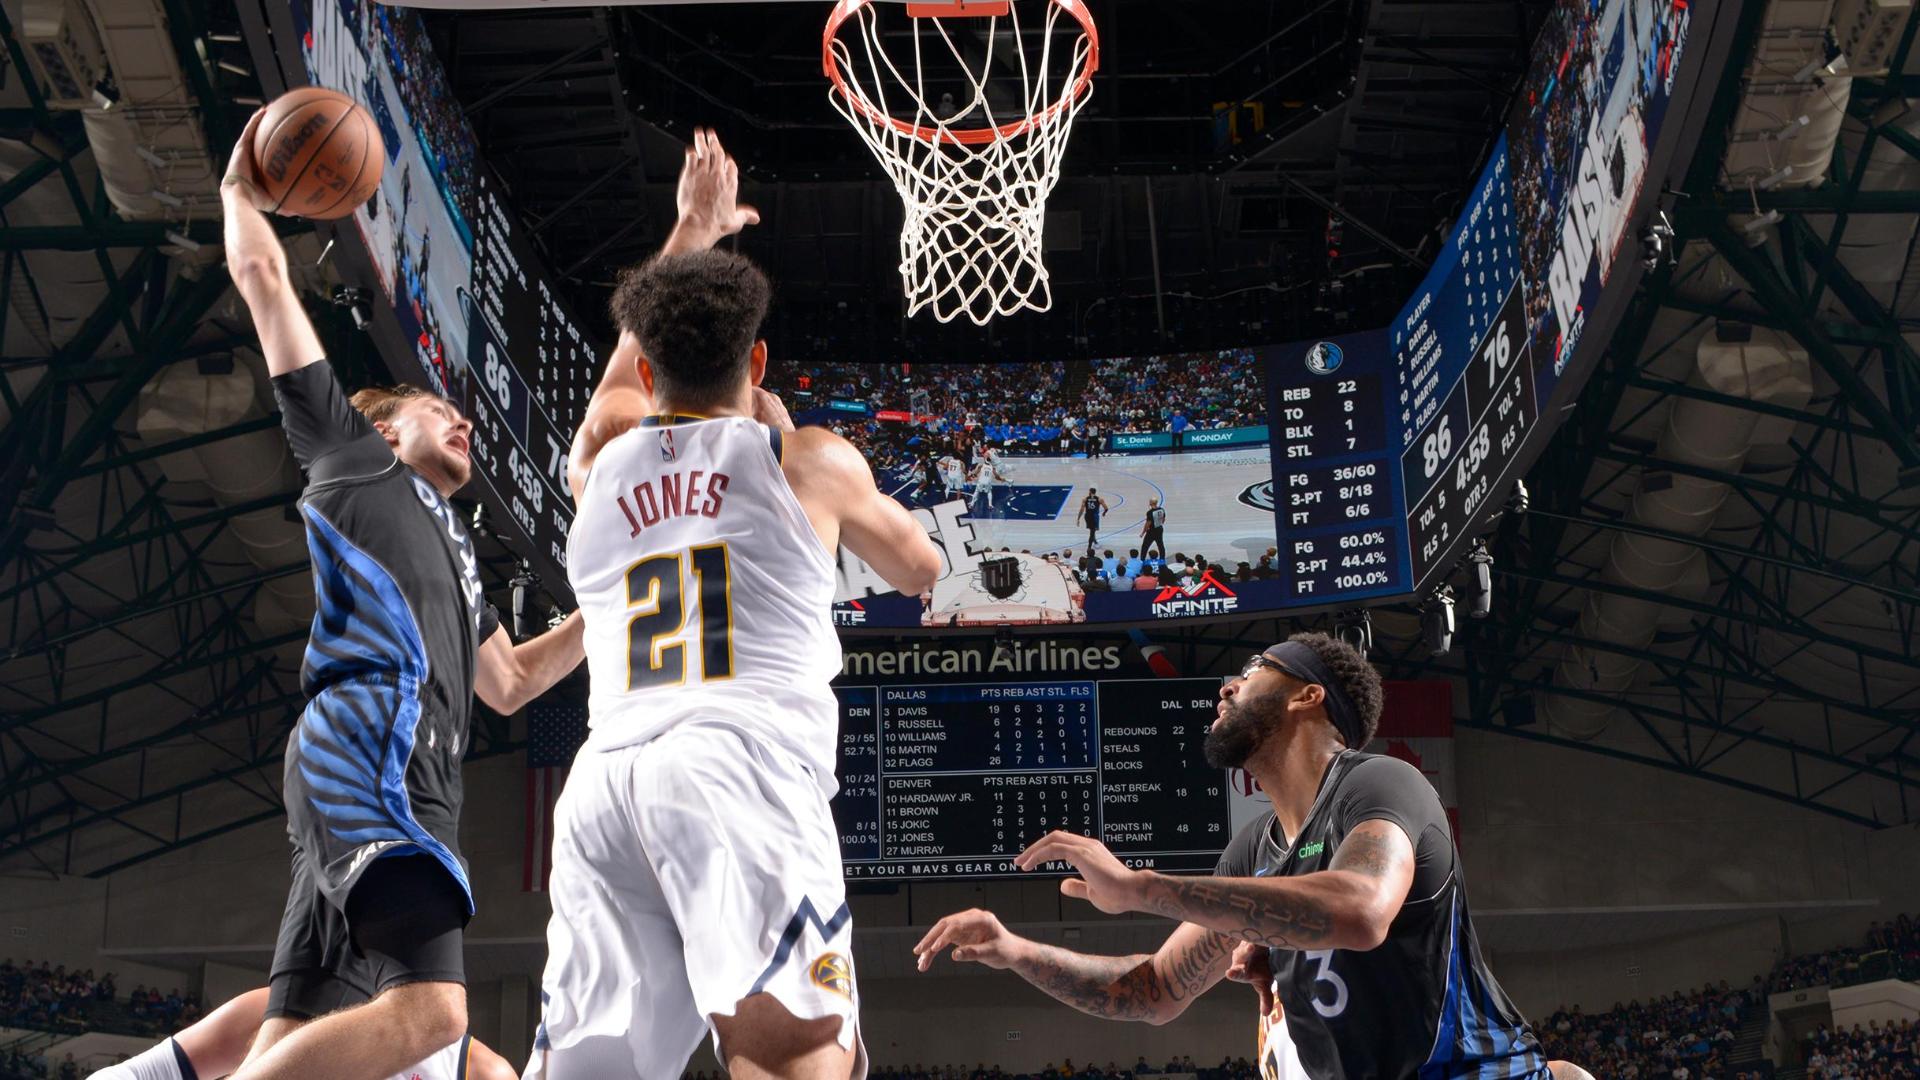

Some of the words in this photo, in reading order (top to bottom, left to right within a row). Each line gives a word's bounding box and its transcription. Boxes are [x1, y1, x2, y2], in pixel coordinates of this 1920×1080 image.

[1407, 293, 1430, 330] PLAYER
[1408, 319, 1428, 352] DAVIS
[1411, 329, 1438, 371] RUSSELL
[1484, 320, 1510, 389] 76
[485, 342, 510, 410] 86
[1412, 344, 1442, 389] WILLIAMS
[1283, 388, 1311, 401] REB
[1338, 380, 1356, 393] 22
[1414, 372, 1438, 410] MARTIN
[1497, 391, 1514, 421] TOL
[1515, 376, 1521, 396] 3
[475, 394, 488, 428] TOL
[492, 420, 499, 442] 5
[1284, 408, 1303, 420] TO
[1344, 400, 1353, 412] 8
[1416, 397, 1437, 430] FLAGG
[1192, 433, 1232, 442] MONDAY
[1286, 425, 1313, 439] BLK
[1345, 419, 1353, 430] 1
[1501, 425, 1516, 455] FLS
[1519, 410, 1524, 428] 1
[474, 430, 488, 461] FLS
[491, 456, 497, 477] 2
[1287, 445, 1312, 458] STL
[1346, 438, 1356, 449] 7
[1423, 415, 1451, 478] 86
[1456, 424, 1490, 490] 4:58
[508, 447, 543, 514] 4:58
[1290, 474, 1308, 486] FG
[1334, 464, 1375, 481] 36/60
[1480, 475, 1487, 494] 3
[1291, 491, 1322, 505] 3-PT
[1339, 484, 1373, 499] 8/18
[617, 471, 730, 539] JONES
[1293, 512, 1309, 524] FT
[1346, 504, 1370, 517] 6/6
[1420, 505, 1435, 531] TOL
[1439, 490, 1446, 509] 5
[1295, 541, 1314, 554] FG
[1340, 532, 1384, 548] 60.0%
[1423, 534, 1438, 562] FLS
[1441, 522, 1448, 541] 2
[1296, 559, 1328, 573] 3-PT
[1341, 552, 1386, 568] 44.4%
[1298, 580, 1314, 593] FT
[1335, 571, 1388, 588] 100.0%
[1152, 597, 1238, 614] INFINITE
[625, 540, 735, 692] 21
[988, 641, 1121, 672] Airlines
[887, 691, 926, 700] DALLAS
[981, 689, 1001, 697] PTS
[1003, 688, 1024, 697] REB
[1026, 688, 1045, 696] AST
[1048, 687, 1066, 696] STL
[1071, 686, 1090, 696] FLS
[849, 708, 870, 716] DEN
[884, 708, 890, 716] 3
[898, 707, 927, 716] DAVIS
[989, 705, 1000, 714] 19
[1014, 705, 1021, 713] 6
[1037, 704, 1042, 712] 3
[1058, 704, 1064, 712] 2
[1080, 703, 1085, 712] 2
[1162, 700, 1183, 709] DAL
[1192, 700, 1212, 708] DEN
[884, 721, 890, 729] 5
[898, 720, 944, 728] RUSSELL
[994, 718, 1000, 726] 6
[1015, 717, 1021, 726] 2
[1037, 717, 1042, 725] 4
[1058, 716, 1064, 725] 0
[1080, 716, 1086, 724] 0
[1104, 727, 1157, 736] REBOUNDS
[1173, 726, 1184, 735] 22
[885, 733, 896, 742] 10
[898, 732, 946, 741] WILLIAMS
[1015, 730, 1021, 739] 0
[1037, 730, 1043, 738] 2
[1059, 729, 1065, 737] 0
[885, 746, 896, 754] 16
[899, 745, 937, 754] MARTIN
[1016, 743, 1022, 751] 2
[1104, 744, 1140, 753] STEALS
[1179, 743, 1185, 751] 7
[885, 759, 896, 767] 32
[899, 758, 933, 767] FLAGG
[989, 756, 1001, 765] 26
[1016, 756, 1022, 764] 7
[1038, 755, 1044, 763] 6
[1104, 761, 1143, 770] BLOCKS
[889, 779, 931, 788] DENVER
[984, 777, 1003, 786] PTS
[1006, 776, 1026, 785] REB
[1028, 776, 1048, 785] AST
[1050, 776, 1069, 784] STL
[1074, 775, 1092, 784] FLS
[1103, 784, 1127, 792] FAST
[1129, 783, 1161, 792] BREAK
[886, 795, 897, 803] 10
[900, 794, 956, 803] HARDAWAY
[959, 793, 974, 802] JR.
[994, 792, 1003, 800] 11
[1018, 792, 1023, 800] 2
[1039, 791, 1045, 799] 0
[1061, 791, 1067, 799] 0
[1083, 790, 1089, 799] 0
[1103, 794, 1138, 803] POINTS
[1176, 788, 1187, 797] 18
[1207, 787, 1218, 796] 10
[887, 808, 895, 816] 11
[900, 807, 938, 816] BROWN
[997, 805, 1003, 814] 2
[1018, 805, 1024, 813] 3
[1083, 803, 1089, 811] 0
[887, 821, 898, 829] 15
[900, 820, 930, 829] JOKIC
[992, 818, 1003, 826] 18
[1018, 818, 1024, 826] 5
[1040, 817, 1046, 825] 9
[1104, 823, 1140, 831] POINTS
[1142, 822, 1152, 830] IN
[1177, 824, 1189, 832] 48
[1208, 823, 1220, 832] 28
[886, 834, 896, 842] 21
[900, 833, 934, 842] JONES
[997, 831, 1003, 839] 6
[1018, 831, 1024, 839] 4
[1105, 834, 1123, 842] THE
[1126, 833, 1153, 841] PAINT
[887, 847, 898, 855] 27
[901, 846, 944, 855] MURRAY
[992, 844, 1003, 853] 24
[868, 865, 905, 875] YOUR
[912, 864, 948, 873] MAVS
[955, 863, 992, 872] GEAR
[999, 862, 1018, 871] ON
[1306, 949, 1348, 1018] 3
